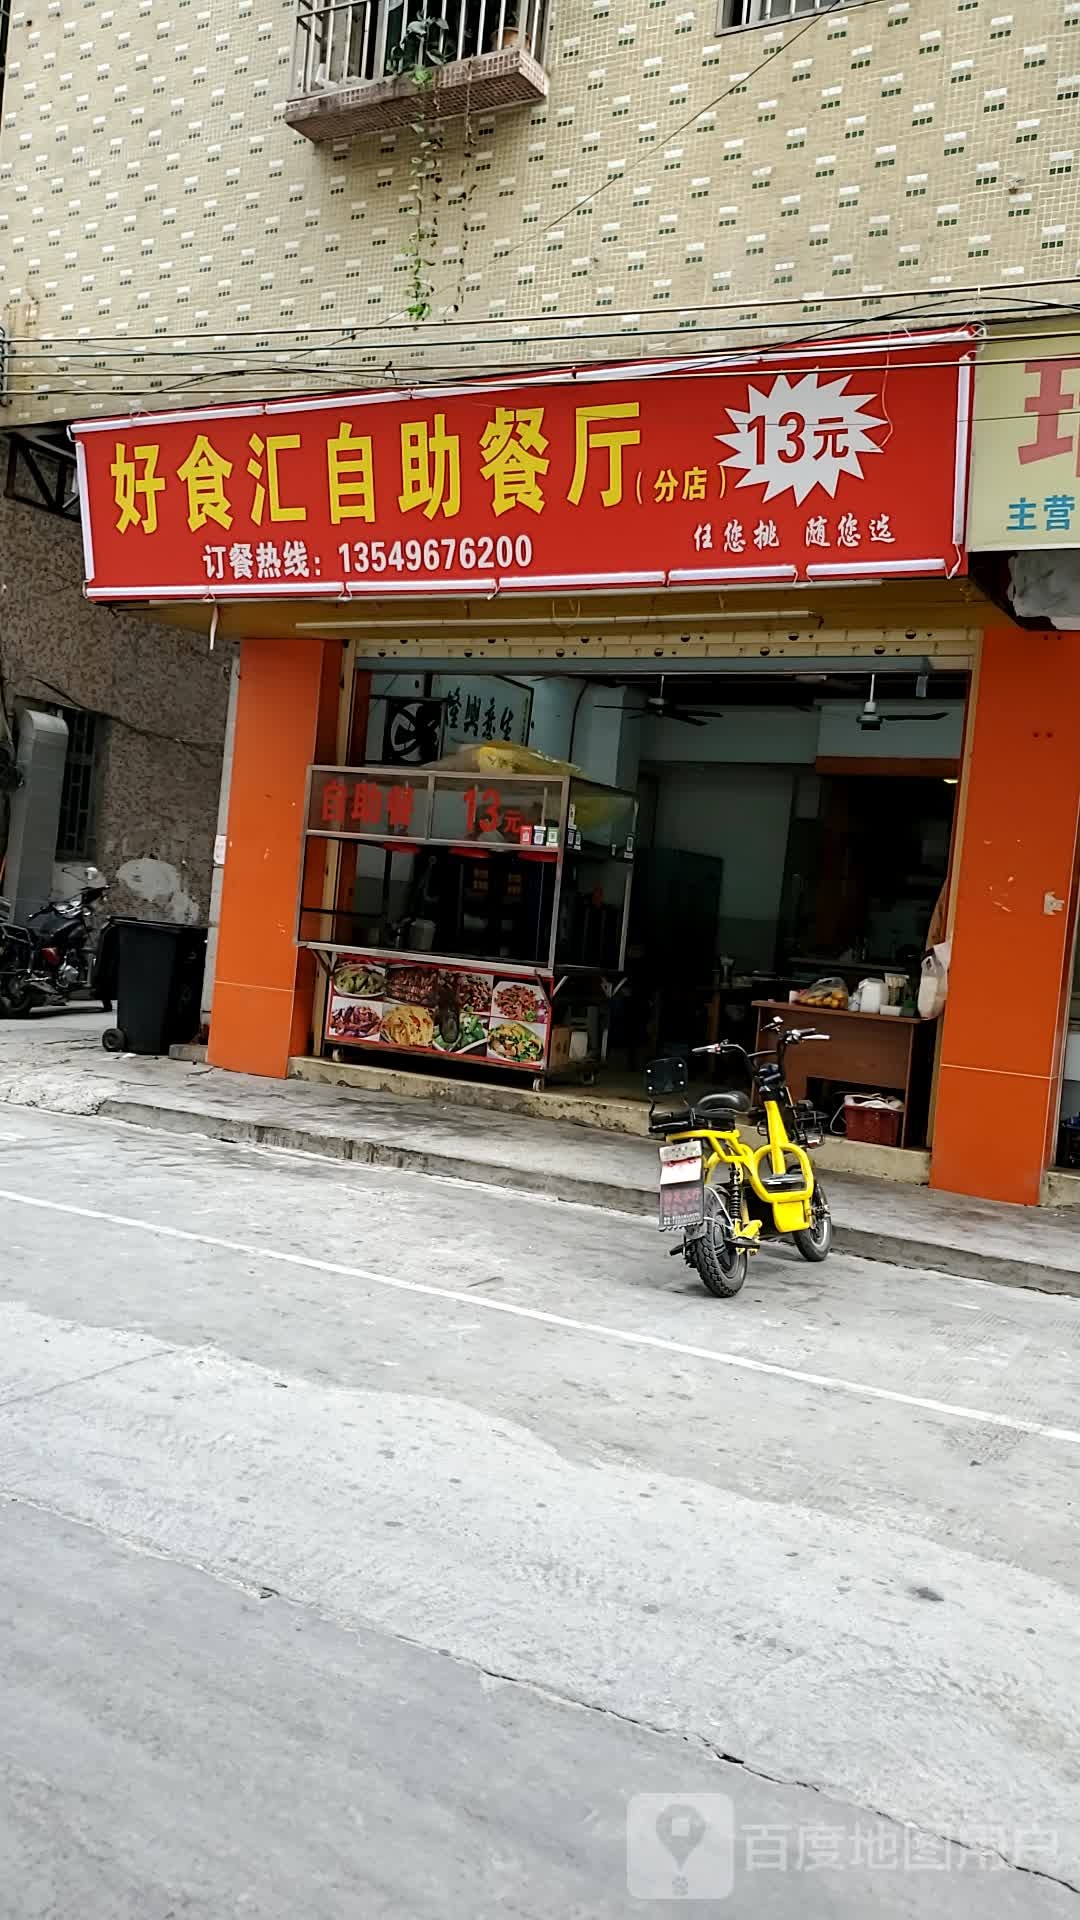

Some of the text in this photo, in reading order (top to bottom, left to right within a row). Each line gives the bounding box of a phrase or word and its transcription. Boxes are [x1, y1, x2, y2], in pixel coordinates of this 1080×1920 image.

[746, 411, 850, 465] 13元
[110, 402, 641, 534] 好食汇自助餐厅
[694, 512, 896, 553] 任您挑 随您选
[1006, 495, 1075, 531] 主营
[338, 534, 532, 573] 13549676200
[321, 779, 523, 833] 自助餐 13元
